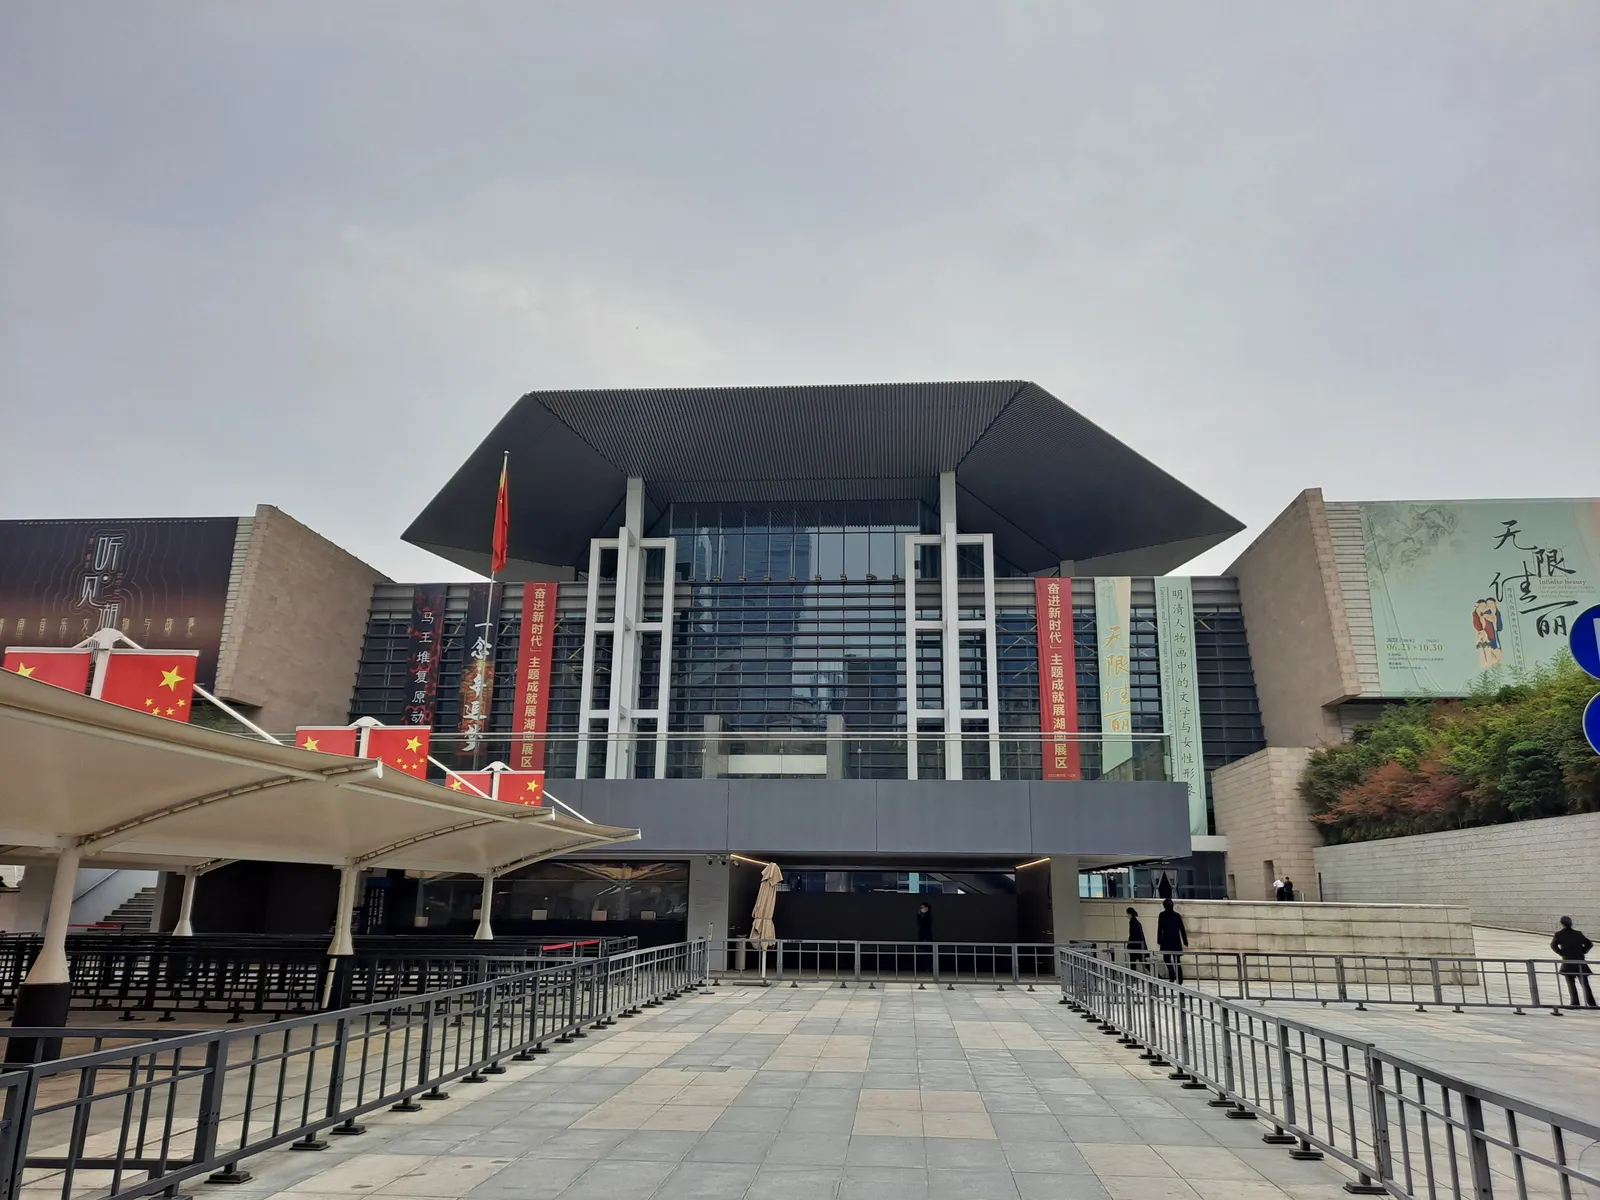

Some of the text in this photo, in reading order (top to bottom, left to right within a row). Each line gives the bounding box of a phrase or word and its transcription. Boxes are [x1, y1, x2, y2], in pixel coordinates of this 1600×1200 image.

[1489, 519, 1578, 638] 无限佳丽
[1172, 589, 1196, 796] 明清人物画中的文学与女性形象
